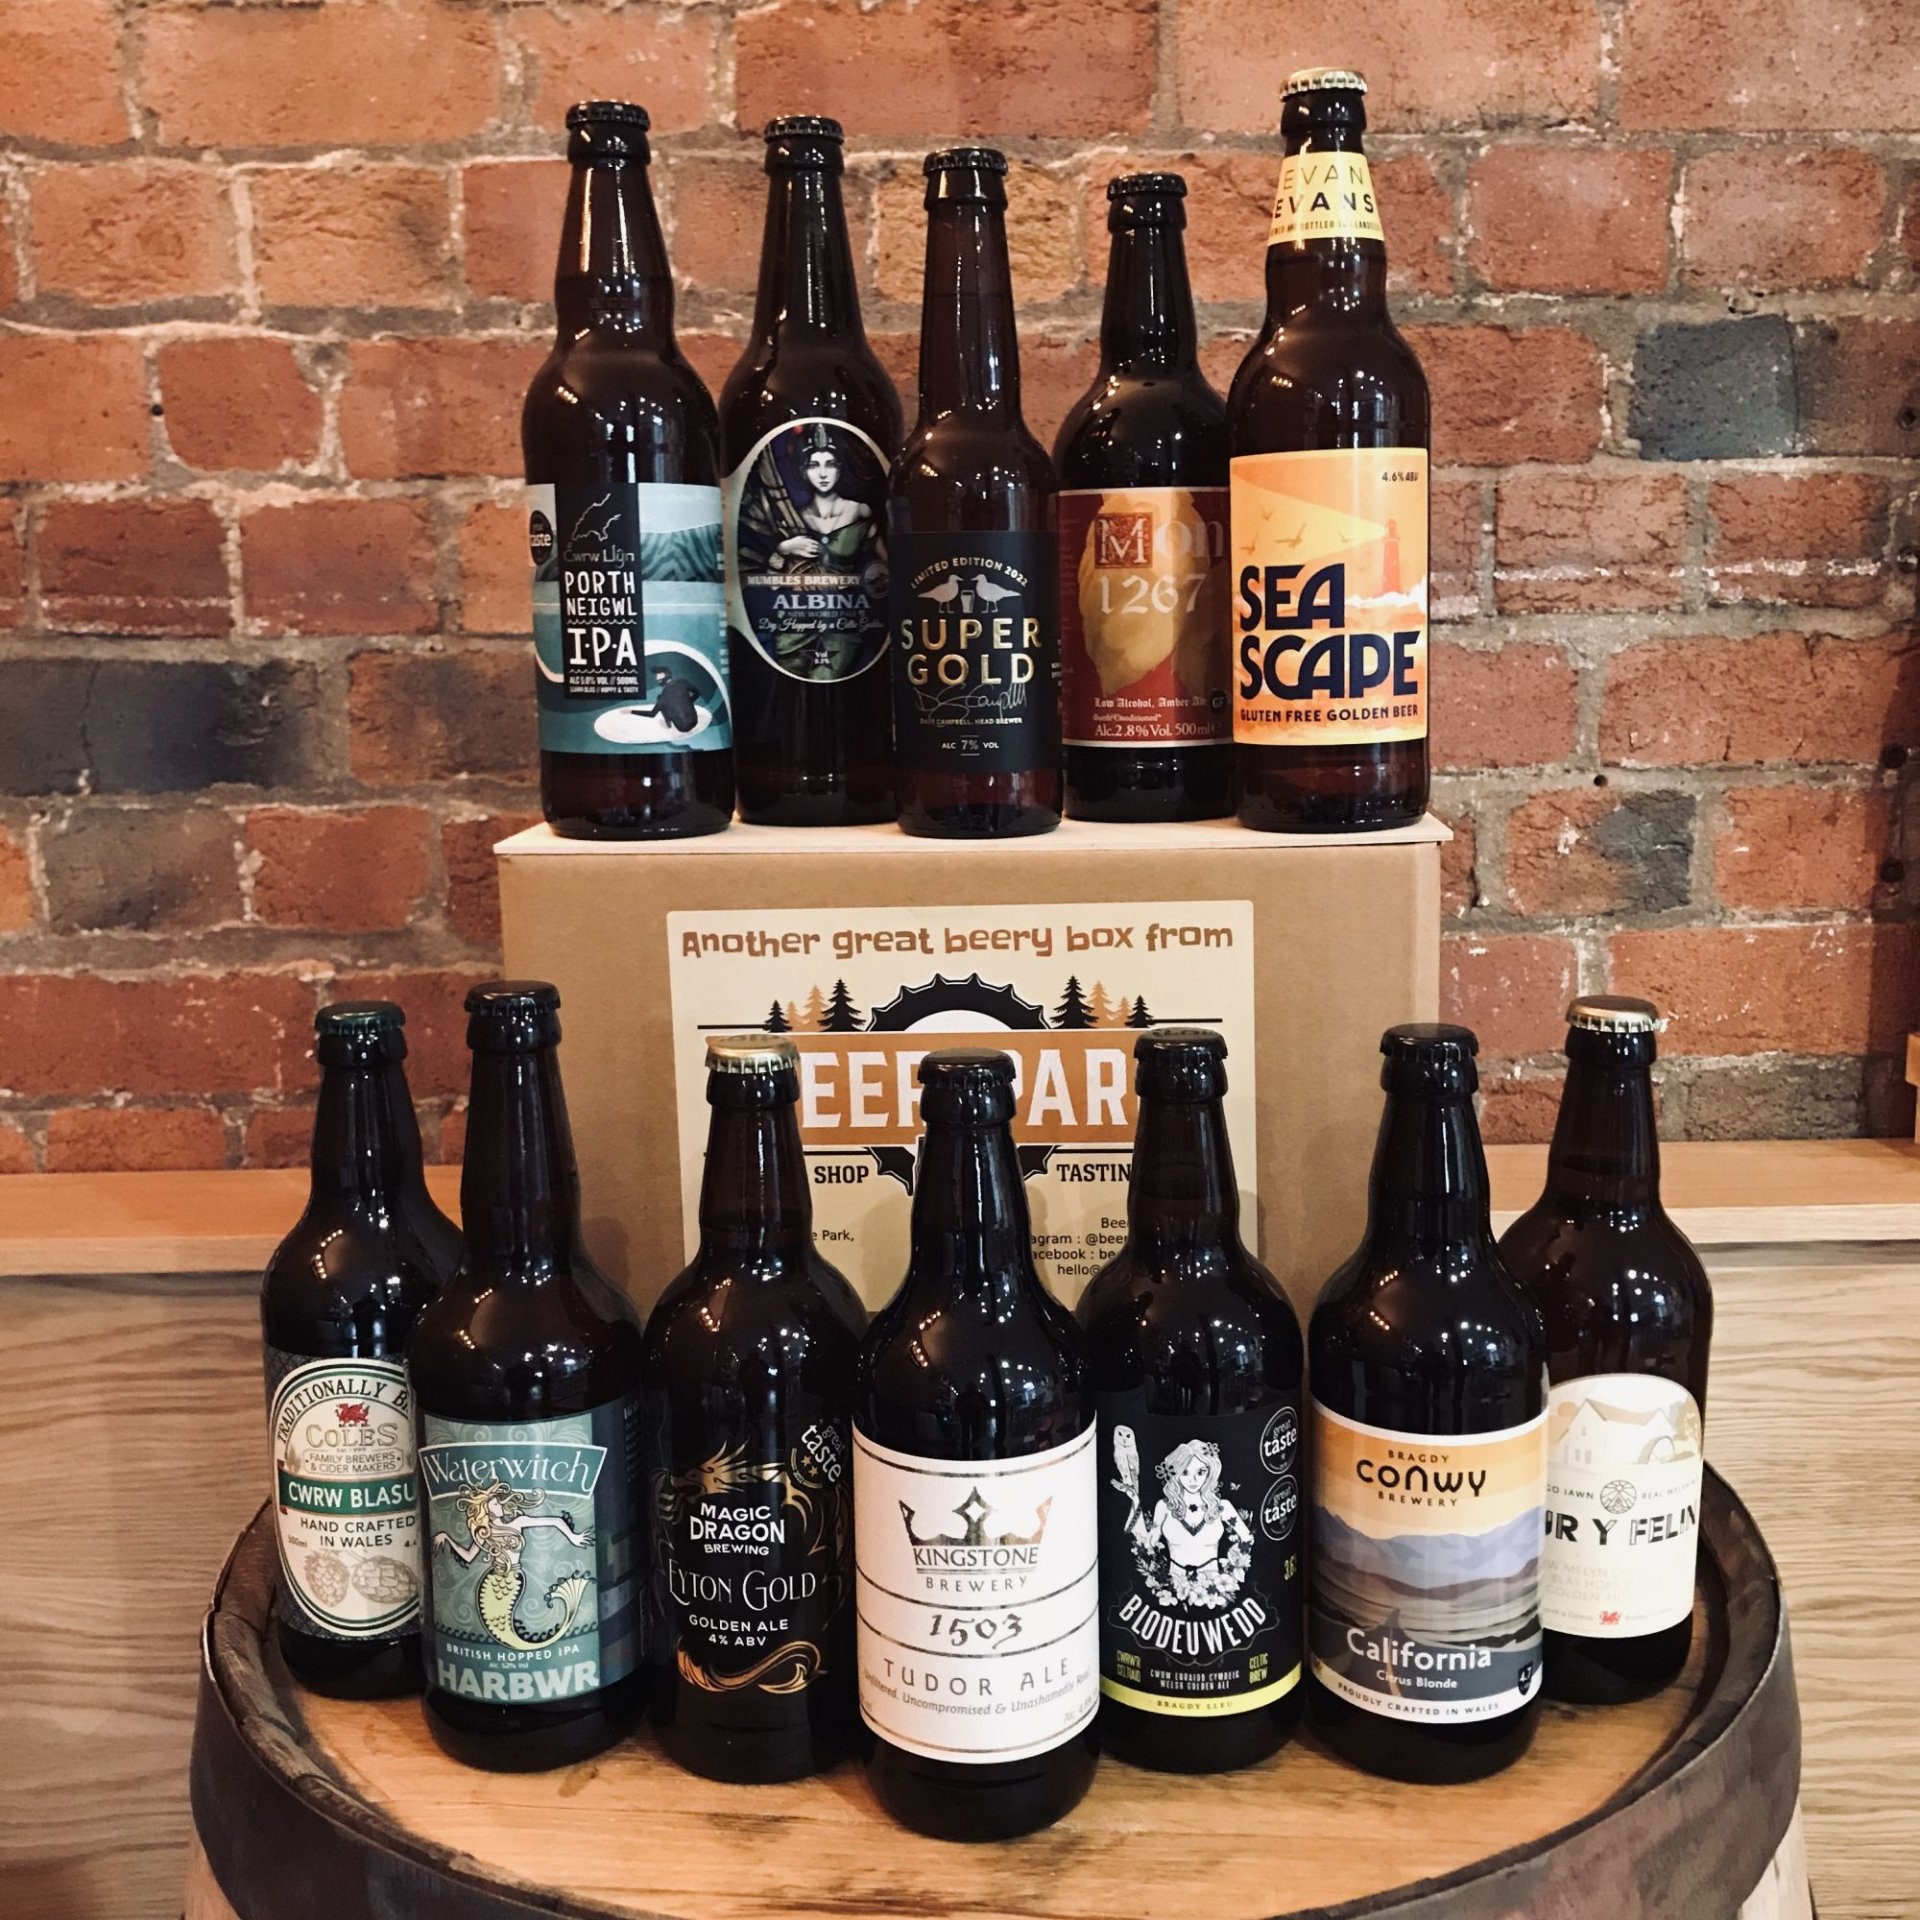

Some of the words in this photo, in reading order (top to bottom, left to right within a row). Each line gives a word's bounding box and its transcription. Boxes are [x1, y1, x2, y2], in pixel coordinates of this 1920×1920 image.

[1283, 165, 1363, 190] EVAN
[1274, 192, 1374, 218] EVANS
[564, 571, 635, 595] PORTH
[747, 575, 801, 585] MUMBLES
[804, 575, 861, 585] BREWERY
[911, 560, 949, 589] LIMITED
[952, 557, 1003, 571] EDITION
[1004, 565, 1029, 588] 2022
[772, 594, 870, 609] ALBINA
[1100, 574, 1208, 615] 1267
[1240, 563, 1345, 632] SEA
[567, 597, 637, 616] NEIGWL
[901, 617, 1042, 650] SUPER
[908, 653, 1035, 685] GOLD
[1240, 631, 1421, 700] SCAPE
[1241, 708, 1282, 723] GLUTEN
[1285, 709, 1322, 722] FREE
[1326, 706, 1389, 721] GOLDEN
[1393, 704, 1419, 717] BEER
[1150, 724, 1173, 736] Vol.
[961, 740, 979, 750] 7%
[682, 929, 820, 958] Another
[832, 927, 934, 960] great
[944, 926, 1053, 957] beery
[1066, 925, 1134, 953] box
[1146, 922, 1234, 950] from
[802, 1051, 925, 1129] EER
[814, 1165, 870, 1184] SHOP
[1056, 1163, 1131, 1182] TASTIN
[822, 1229, 855, 1242] Park,
[277, 1378, 387, 1445] TRADITIONALLY
[1273, 1419, 1291, 1439] great
[801, 1424, 842, 1482] taste
[1264, 1429, 1297, 1457] taste
[309, 1453, 343, 1464] FAMILY
[346, 1451, 396, 1463] BREWERS
[310, 1462, 317, 1470] &
[319, 1463, 349, 1472] CIDER
[352, 1461, 396, 1472] MAKERS
[1388, 1450, 1450, 1463] BRAGDY
[424, 1451, 594, 1493] Waterwitch
[288, 1481, 342, 1508] CWRW
[351, 1482, 415, 1508] BLASU
[1273, 1486, 1291, 1505] great
[1378, 1491, 1458, 1507] BREWERY
[1563, 1488, 1594, 1500] IAWN
[700, 1502, 772, 1521] MAGIC
[1264, 1495, 1297, 1524] taste
[300, 1516, 339, 1533] HAND
[345, 1515, 415, 1533] CRAFTED
[690, 1515, 785, 1544] DRAGON
[1592, 1518, 1617, 1545] Y
[320, 1535, 336, 1547] IN
[341, 1534, 393, 1548] WALES
[704, 1543, 769, 1556] BREWING
[913, 1546, 1038, 1567] KINGSTONE
[668, 1558, 732, 1606] EYTON
[742, 1570, 816, 1611] GOLD
[926, 1575, 1028, 1593] BREWERY
[689, 1614, 751, 1632] GOLDEN
[757, 1618, 789, 1631] ALE
[929, 1613, 1023, 1649] 1503
[1119, 1594, 1266, 1656] BLODEUWEDD
[708, 1633, 728, 1645] 4%
[735, 1636, 767, 1647] ABV
[1346, 1629, 1492, 1671] California
[446, 1642, 492, 1661] BRITISH
[497, 1650, 552, 1662] HOPPED
[558, 1643, 580, 1656] IPA
[437, 1660, 599, 1700] HARBWR
[883, 1657, 993, 1697] TUDOR
[1020, 1657, 1069, 1691] ALE
[1249, 1667, 1268, 1684] BREW
[1376, 1670, 1412, 1688] Citrus
[1416, 1674, 1458, 1690] Blonde
[902, 1693, 991, 1716] Uncompromised
[995, 1703, 1007, 1714] &
[1011, 1679, 1075, 1713] Unashamedly
[1156, 1700, 1201, 1709] BRAGDY
[1337, 1682, 1383, 1707] PROUDLY
[1387, 1701, 1441, 1716] CRAFTED
[1446, 1707, 1459, 1715] IN
[1464, 1702, 1499, 1715] WALES
